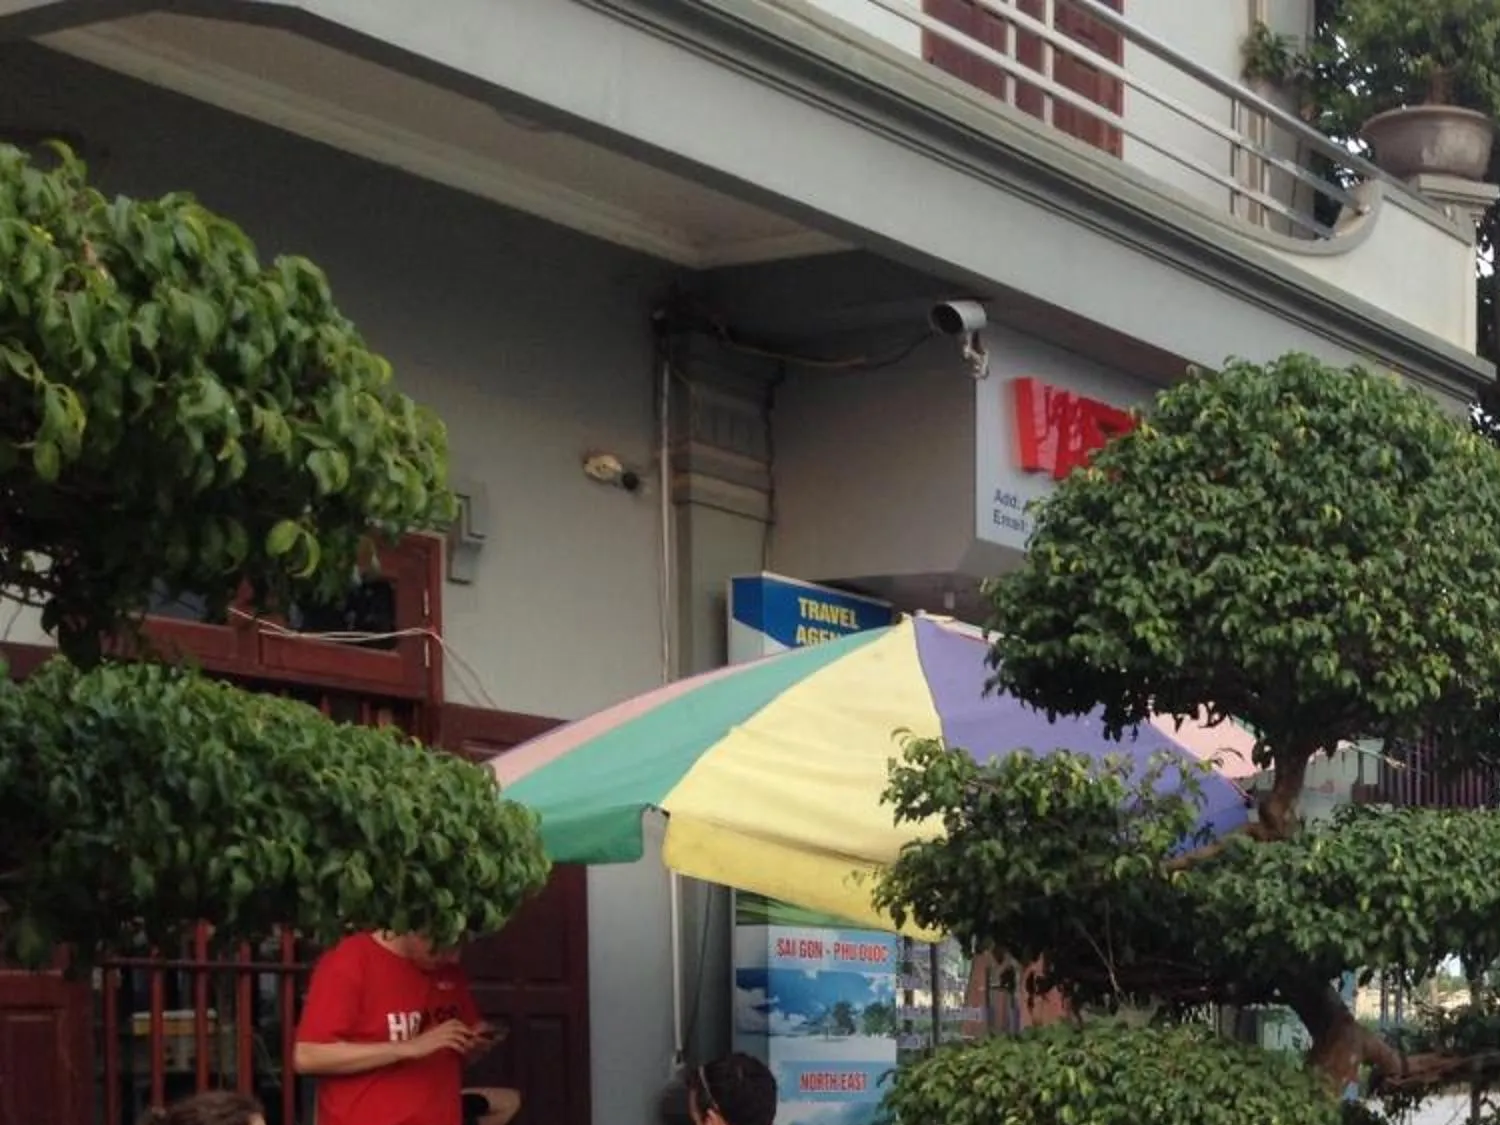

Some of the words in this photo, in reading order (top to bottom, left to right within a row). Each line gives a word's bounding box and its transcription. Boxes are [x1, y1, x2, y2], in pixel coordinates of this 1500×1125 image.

[798, 597, 859, 630] TRAVEL
[776, 937, 797, 957] SAI
[800, 939, 823, 960] GON
